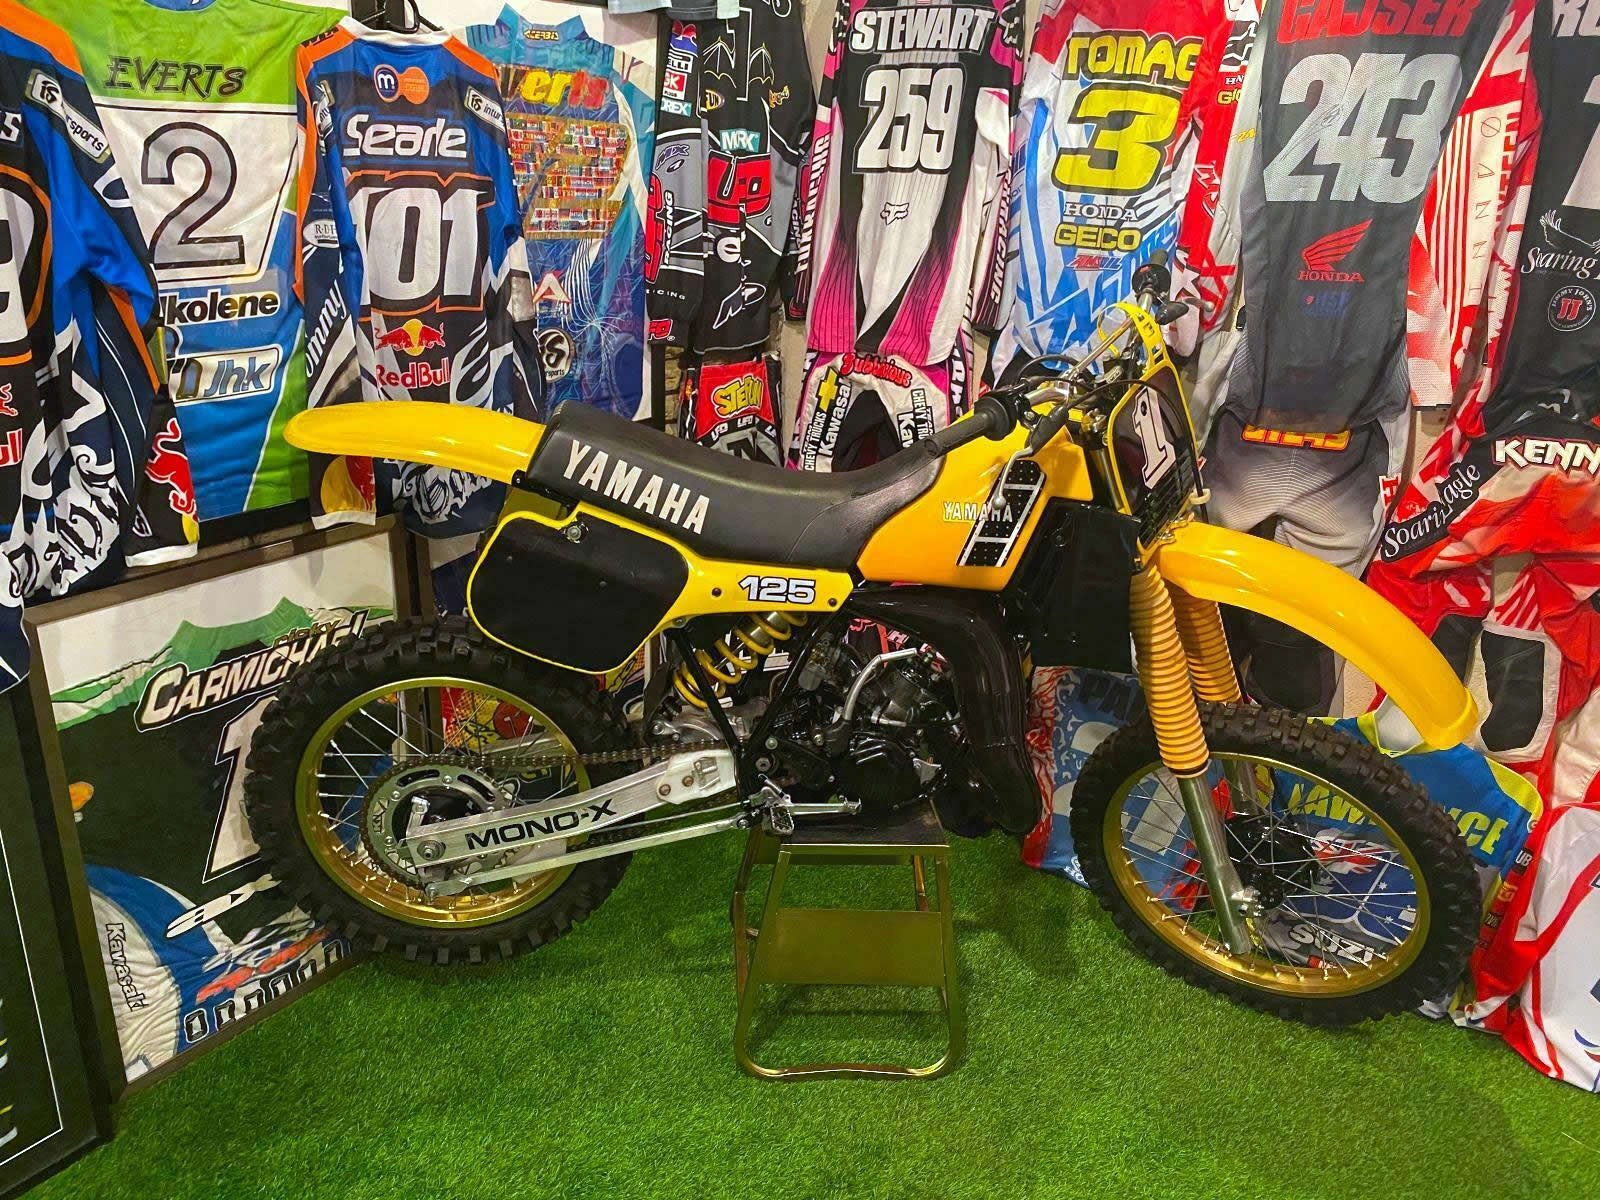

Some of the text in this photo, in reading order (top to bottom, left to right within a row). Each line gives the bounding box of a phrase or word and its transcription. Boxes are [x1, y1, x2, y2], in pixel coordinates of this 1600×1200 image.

[851, 8, 995, 51] STEWART
[104, 55, 248, 99] EVERTS
[343, 113, 468, 159] Searle
[857, 67, 965, 170] 259
[1055, 88, 1182, 190] 3
[1264, 53, 1463, 203] 243
[141, 121, 246, 271] 2
[1063, 202, 1138, 221] HONDA
[348, 186, 489, 306] 101
[1054, 223, 1141, 251] GECO
[1298, 270, 1365, 283] HONDA
[1557, 297, 1583, 321] JJ
[912, 390, 928, 419] CHEVY
[804, 444, 818, 471] CHEVY
[811, 411, 827, 442] TRUCKS
[1132, 386, 1176, 490] 1
[563, 439, 711, 535] YAMAHA
[943, 502, 1013, 522] YAMAHA
[738, 575, 817, 605] 125
[464, 798, 617, 851] MONO-X
